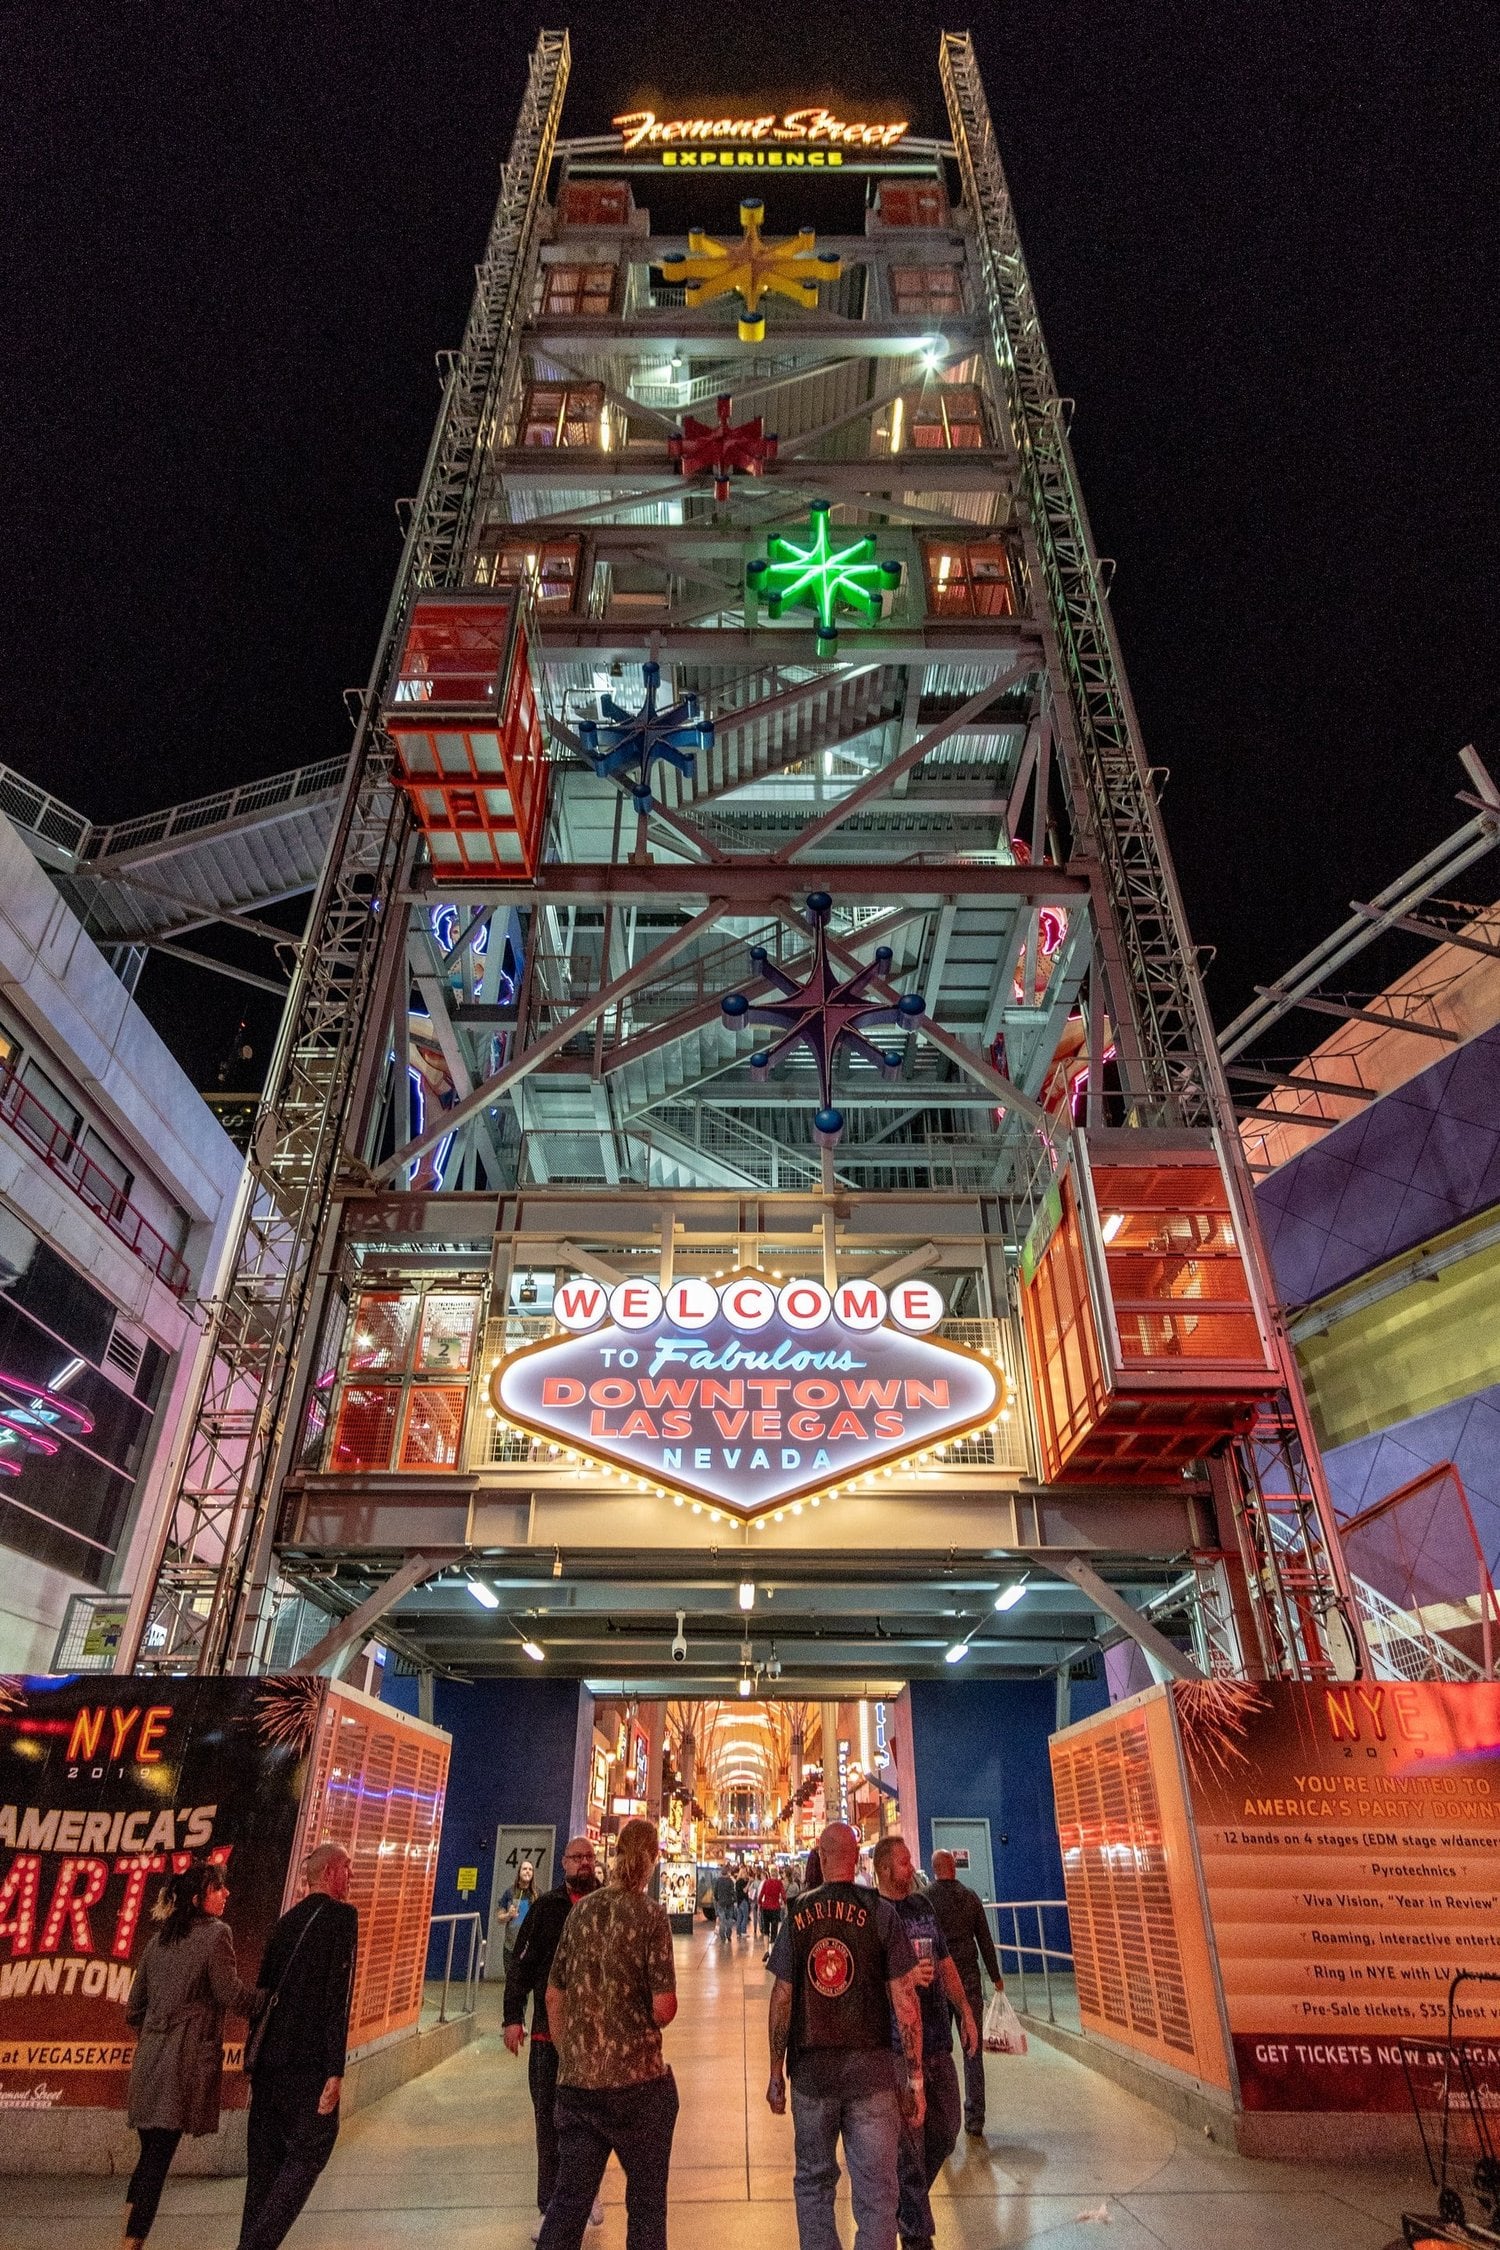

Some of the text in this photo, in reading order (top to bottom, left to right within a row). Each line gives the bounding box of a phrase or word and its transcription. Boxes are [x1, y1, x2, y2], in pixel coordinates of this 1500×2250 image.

[612, 108, 909, 153] Fremont Street
[662, 151, 843, 166] EXPERIENCE
[561, 1288, 933, 1319] WELCOME
[438, 1343, 450, 1357] 2
[600, 1337, 867, 1377] TO Fabulous
[541, 1377, 951, 1410] DOWNTOWN
[589, 1409, 906, 1441] LAS VEGAS
[662, 1448, 832, 1470] NEVADA
[1323, 1686, 1429, 1742] NYE
[65, 1705, 174, 1762] NYE
[1343, 1747, 1424, 1759] 2019
[67, 1767, 152, 1779] 2019
[1293, 1776, 1491, 1796] YOU'RE INVITED TO
[1244, 1799, 1352, 1817] AMERICA'S
[1358, 1800, 1427, 1818] PARTY
[0, 1804, 218, 1852] AMERICA'S
[1224, 1832, 1237, 1843] 12
[1242, 1832, 1280, 1844] bands
[1284, 1835, 1300, 1845] on
[1304, 1833, 1313, 1844] 4
[1316, 1834, 1358, 1848] stages
[1362, 1833, 1398, 1848] (EDM
[1402, 1835, 1437, 1848] stage
[505, 1847, 547, 1868] 477
[1371, 1864, 1456, 1878] Pyrotechnics
[1302, 1893, 1498, 1909] Viva Vision, "Year in Review"
[794, 1900, 867, 1931] MARINES
[1312, 1930, 1375, 1946] Roaming,
[1379, 1931, 1451, 1945] interactive
[1313, 1965, 1345, 1981] Ring
[1350, 1966, 1363, 1979] in
[1367, 1966, 1396, 1979] NYE
[1400, 1967, 1430, 1980] with
[1434, 1967, 1450, 1980] LV
[1302, 2002, 1360, 2016] Pre-Sale
[1365, 2003, 1415, 2018] tickets,
[1420, 2003, 1446, 2018] $35
[2, 2051, 19, 2064] at
[1256, 2044, 1289, 2063] GET
[1295, 2045, 1372, 2064] TICKETS
[1376, 2046, 1420, 2065] NOW
[1427, 2050, 1444, 2065] at
